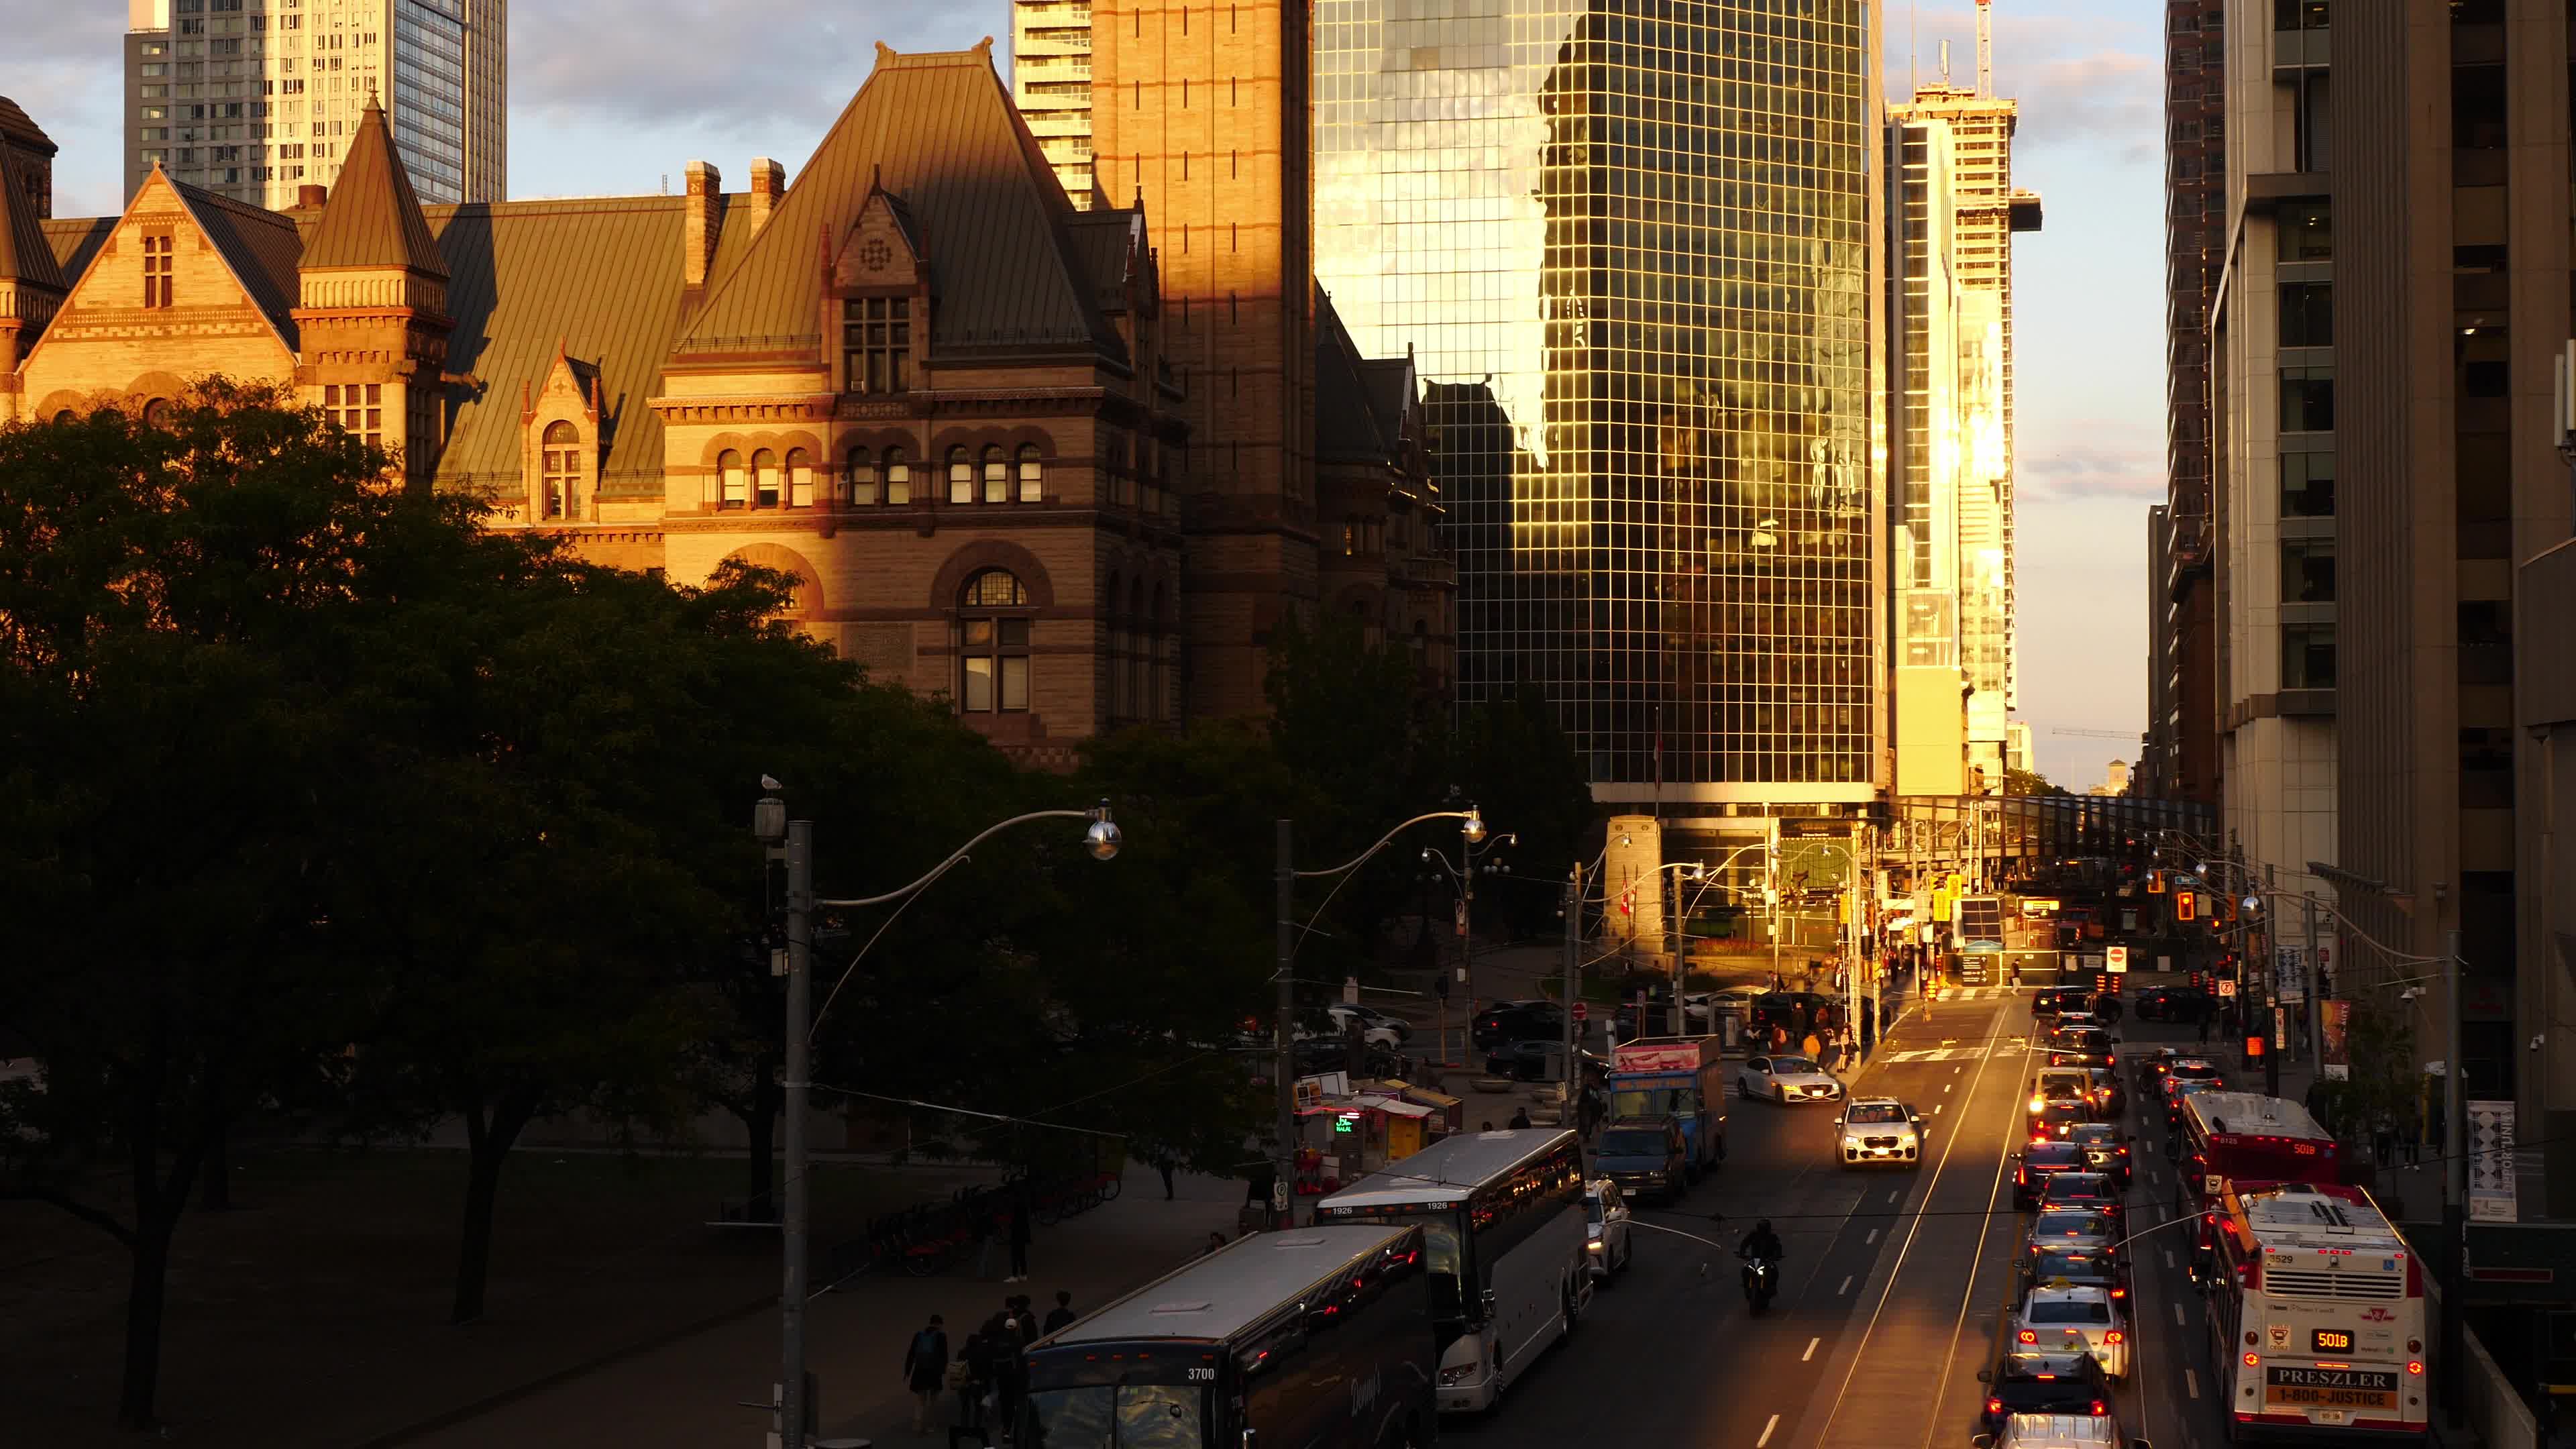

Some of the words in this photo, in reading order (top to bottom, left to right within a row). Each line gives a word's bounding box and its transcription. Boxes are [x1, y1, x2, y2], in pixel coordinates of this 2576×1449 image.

[2294, 1144, 2316, 1155] 501B
[1333, 1207, 1352, 1215] 1926
[1428, 1202, 1448, 1210] 1926
[2269, 1254, 2293, 1264] 3529
[2318, 1333, 2349, 1348] 501B
[1187, 1368, 1215, 1381] 3700
[2278, 1369, 2387, 1387] PRESZLER
[2279, 1388, 2384, 1406] 1-800-JUSTICE
